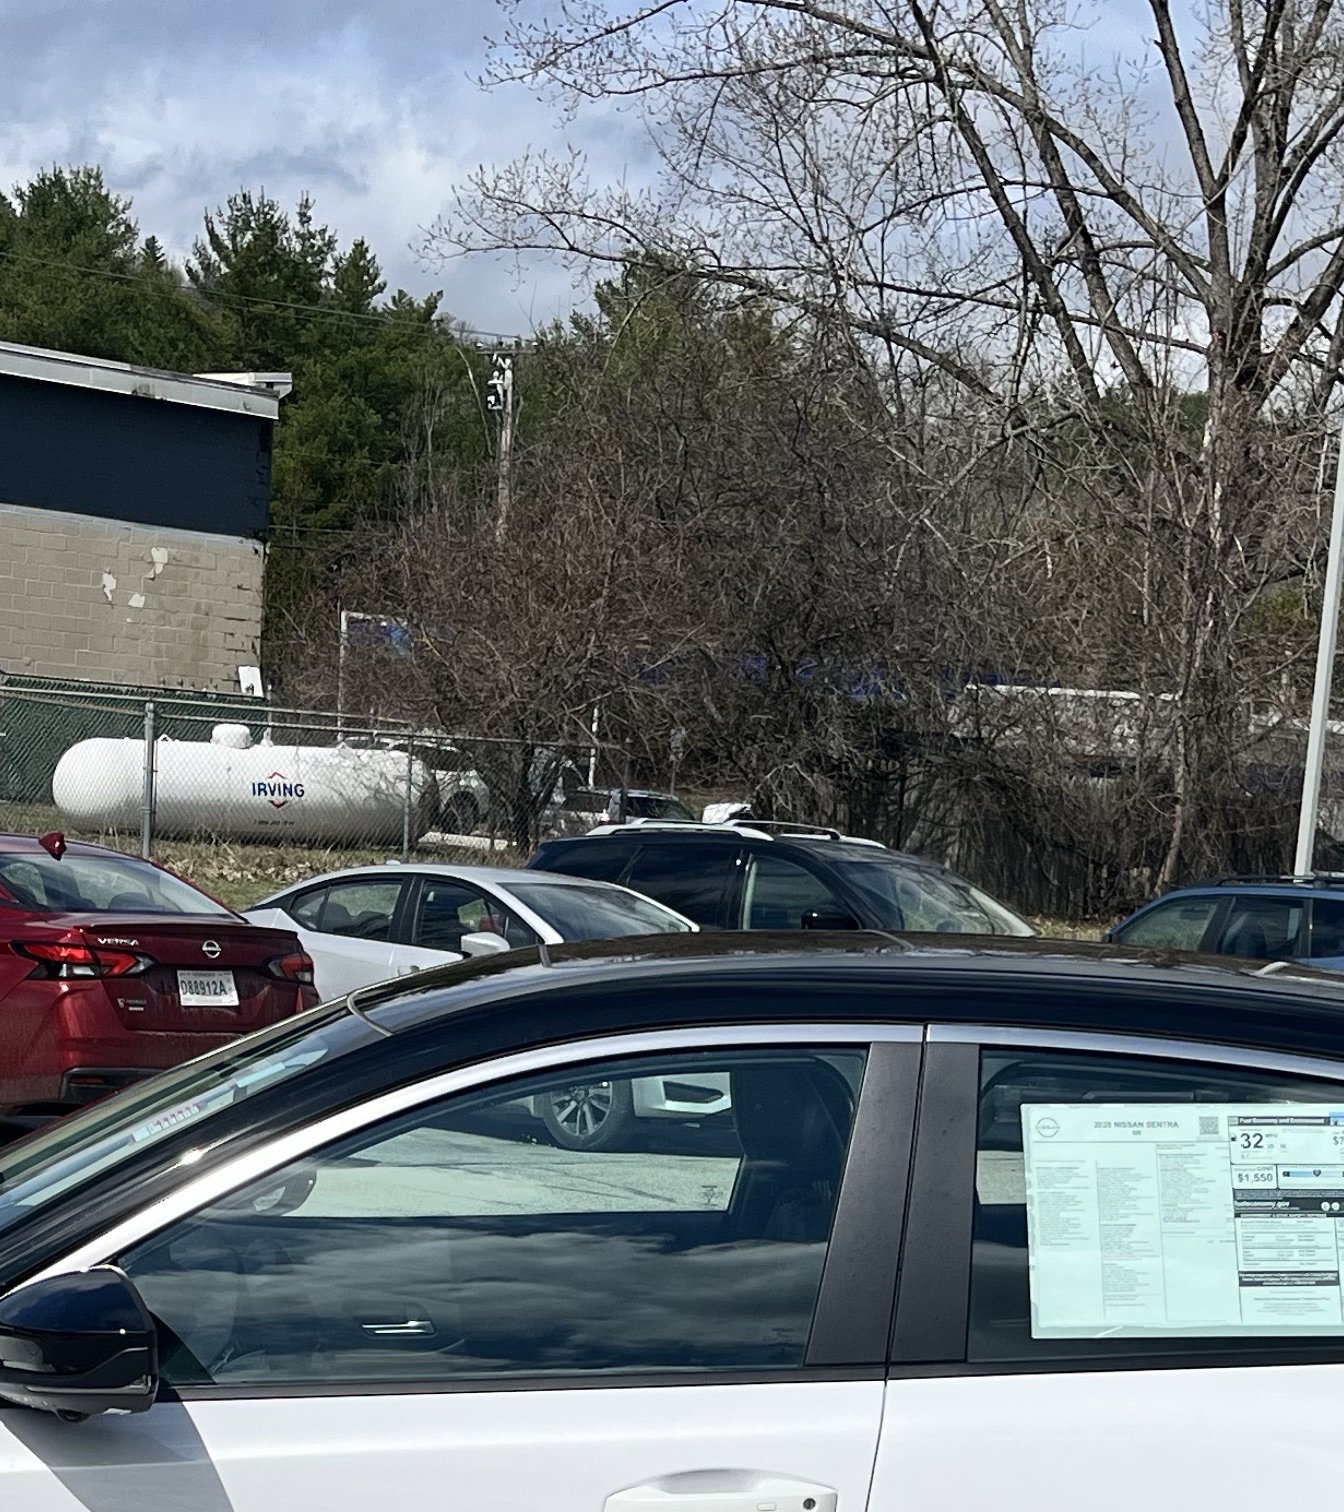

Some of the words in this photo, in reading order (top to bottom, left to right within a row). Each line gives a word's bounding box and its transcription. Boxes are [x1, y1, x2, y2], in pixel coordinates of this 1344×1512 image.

[252, 782, 305, 797] IRVING
[1113, 1121, 1145, 1129] NISSAN
[1146, 1121, 1179, 1129] SENTRA
[1240, 1132, 1264, 1149] 32
[1237, 1172, 1273, 1183] $1,550
